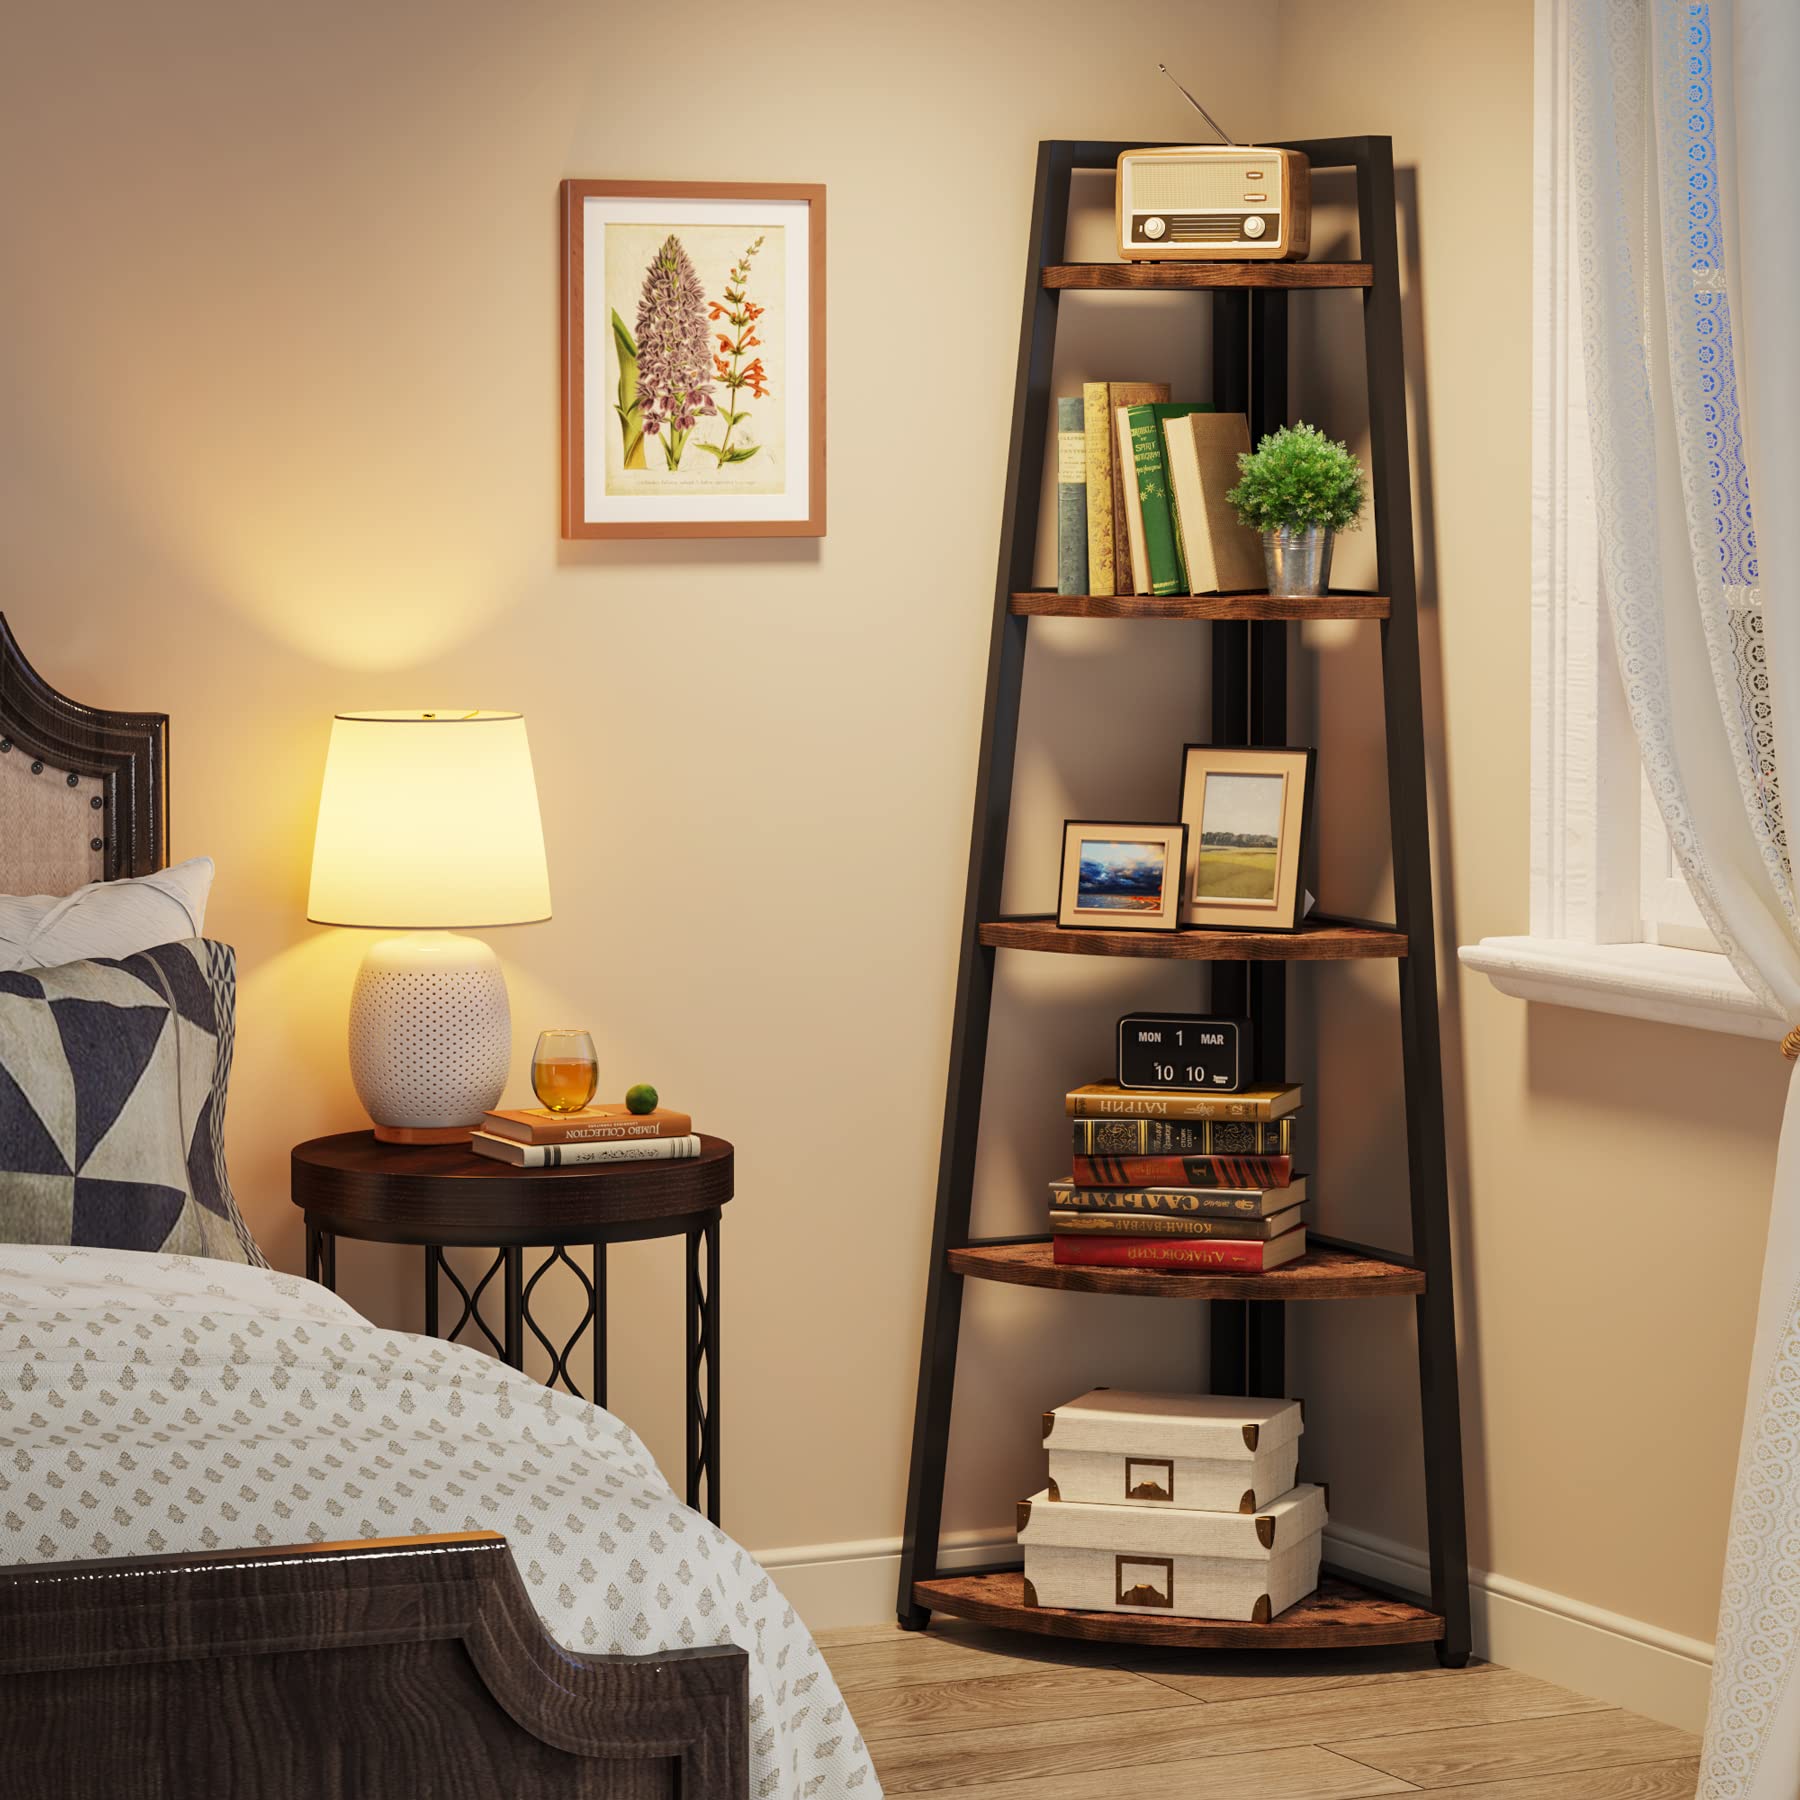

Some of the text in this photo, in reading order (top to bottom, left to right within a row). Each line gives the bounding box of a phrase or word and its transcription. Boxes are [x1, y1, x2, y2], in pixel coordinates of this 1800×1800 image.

[1135, 441, 1156, 452] SPIRIT
[1138, 1030, 1224, 1046] MON 1 MAR
[1155, 1064, 1174, 1081] 10
[1185, 1066, 1205, 1082] 10
[1099, 1100, 1168, 1114] КАТРИН
[565, 1121, 660, 1139] JUMBO COLLECTION
[1053, 1189, 1199, 1211] САЛЬГАРИ
